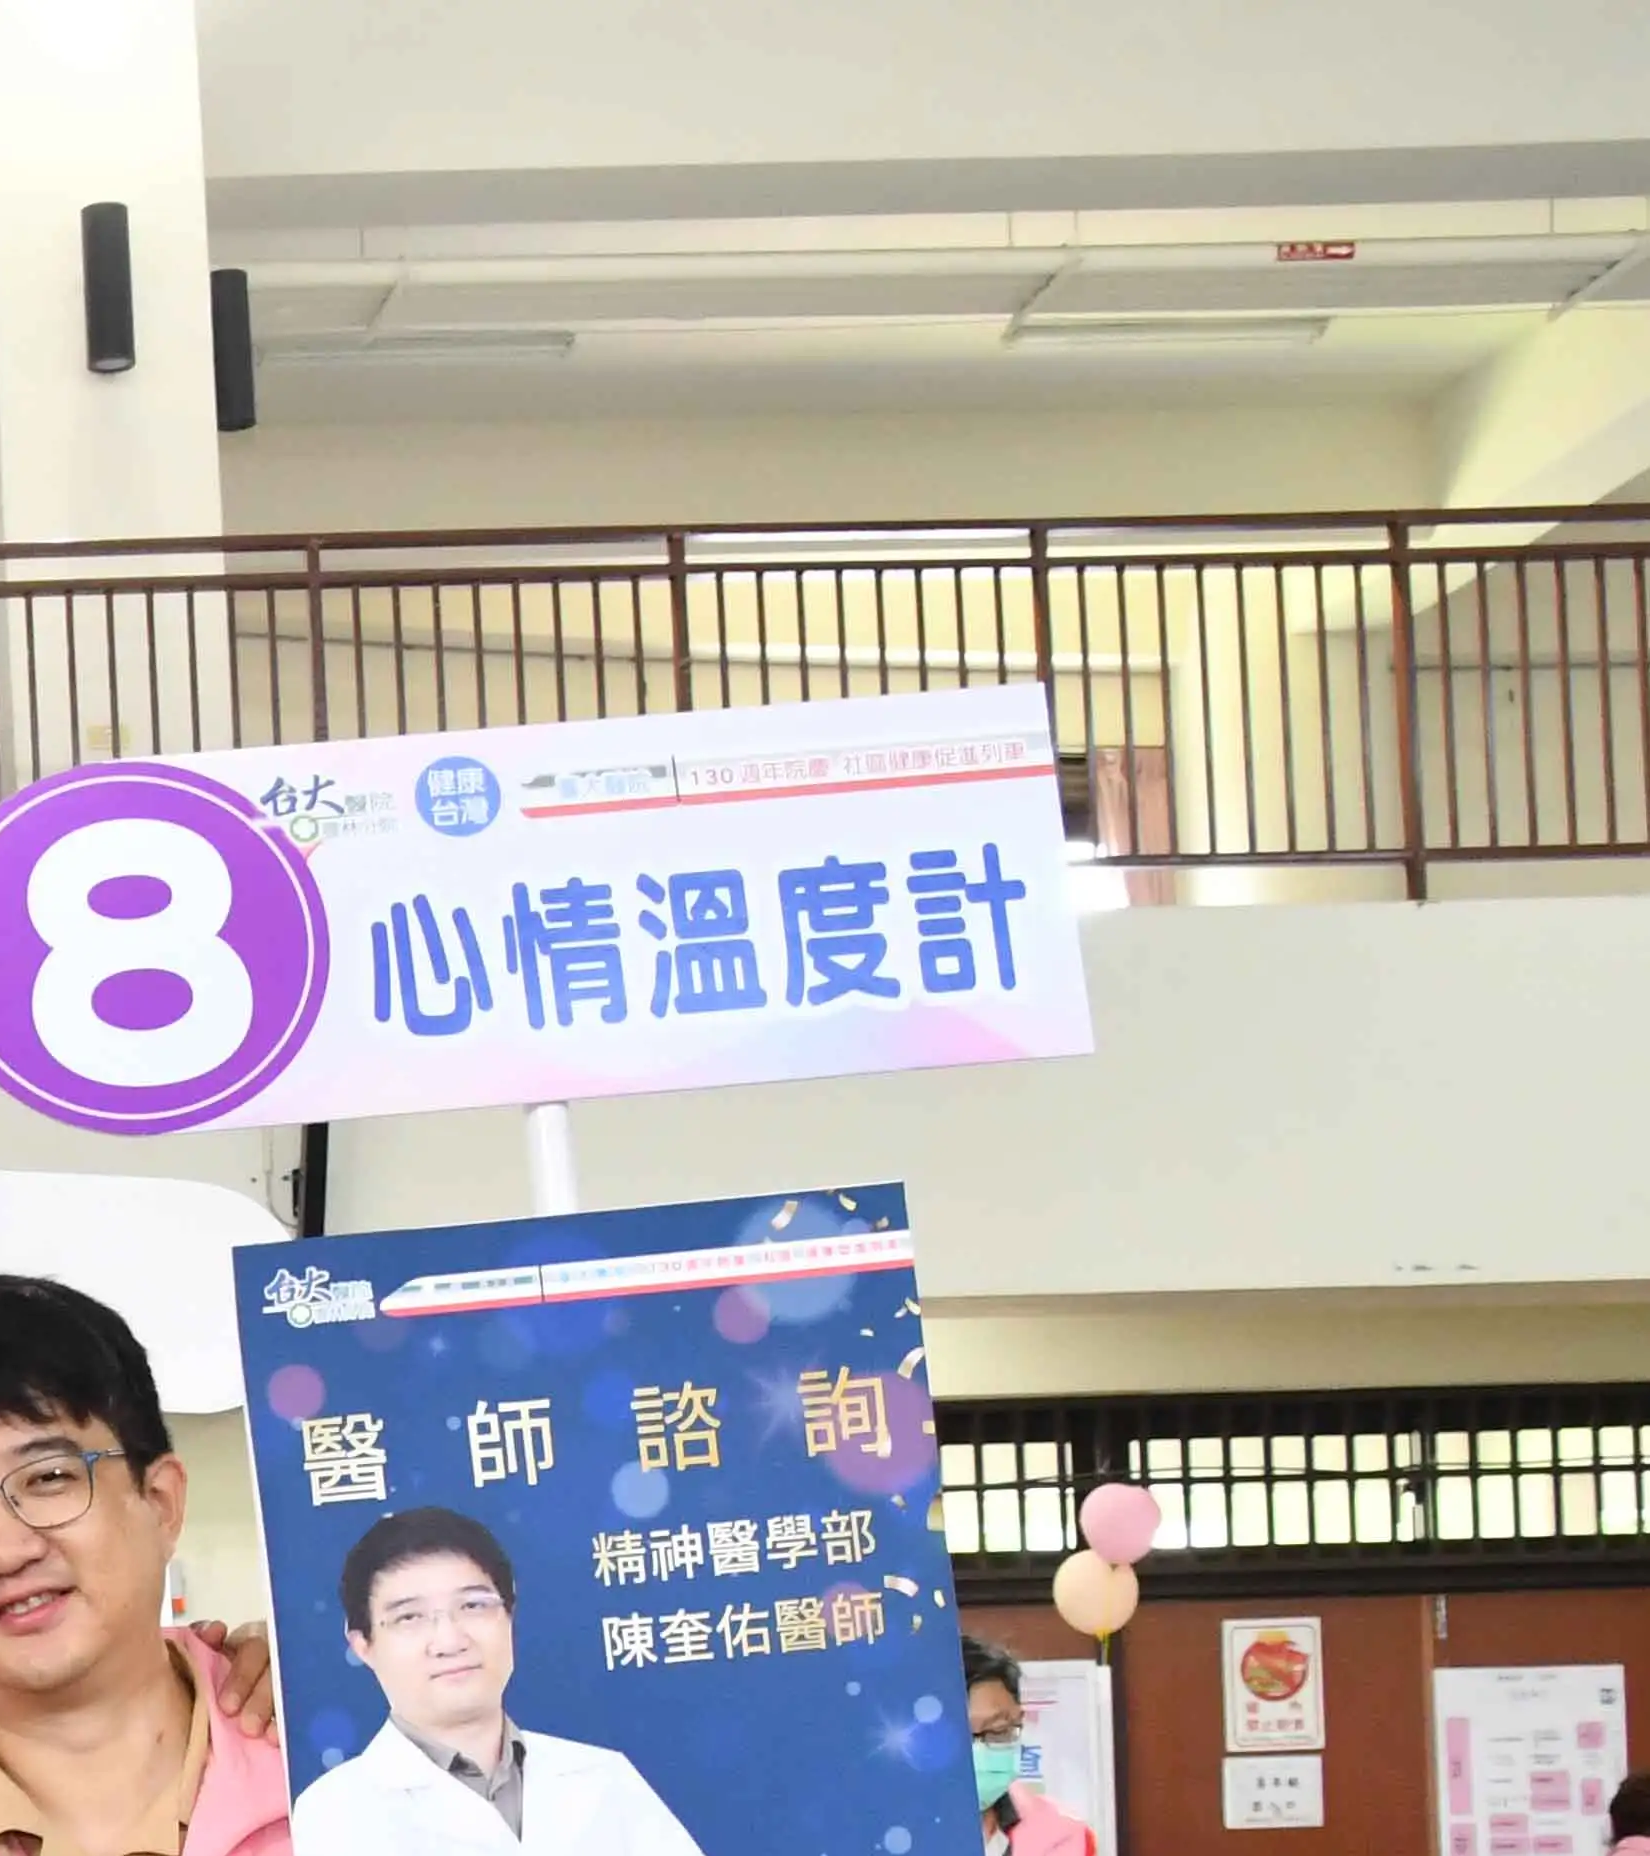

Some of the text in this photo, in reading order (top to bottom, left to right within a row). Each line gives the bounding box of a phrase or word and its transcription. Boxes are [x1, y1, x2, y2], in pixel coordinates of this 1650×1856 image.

[427, 767, 486, 797] 健康
[691, 766, 734, 787] 130
[26, 817, 255, 1087] 8
[370, 842, 1026, 1037] 心情溫度計
[591, 1509, 877, 1588] 精神醫學部
[602, 1591, 886, 1672] 陳奎佑醫師
